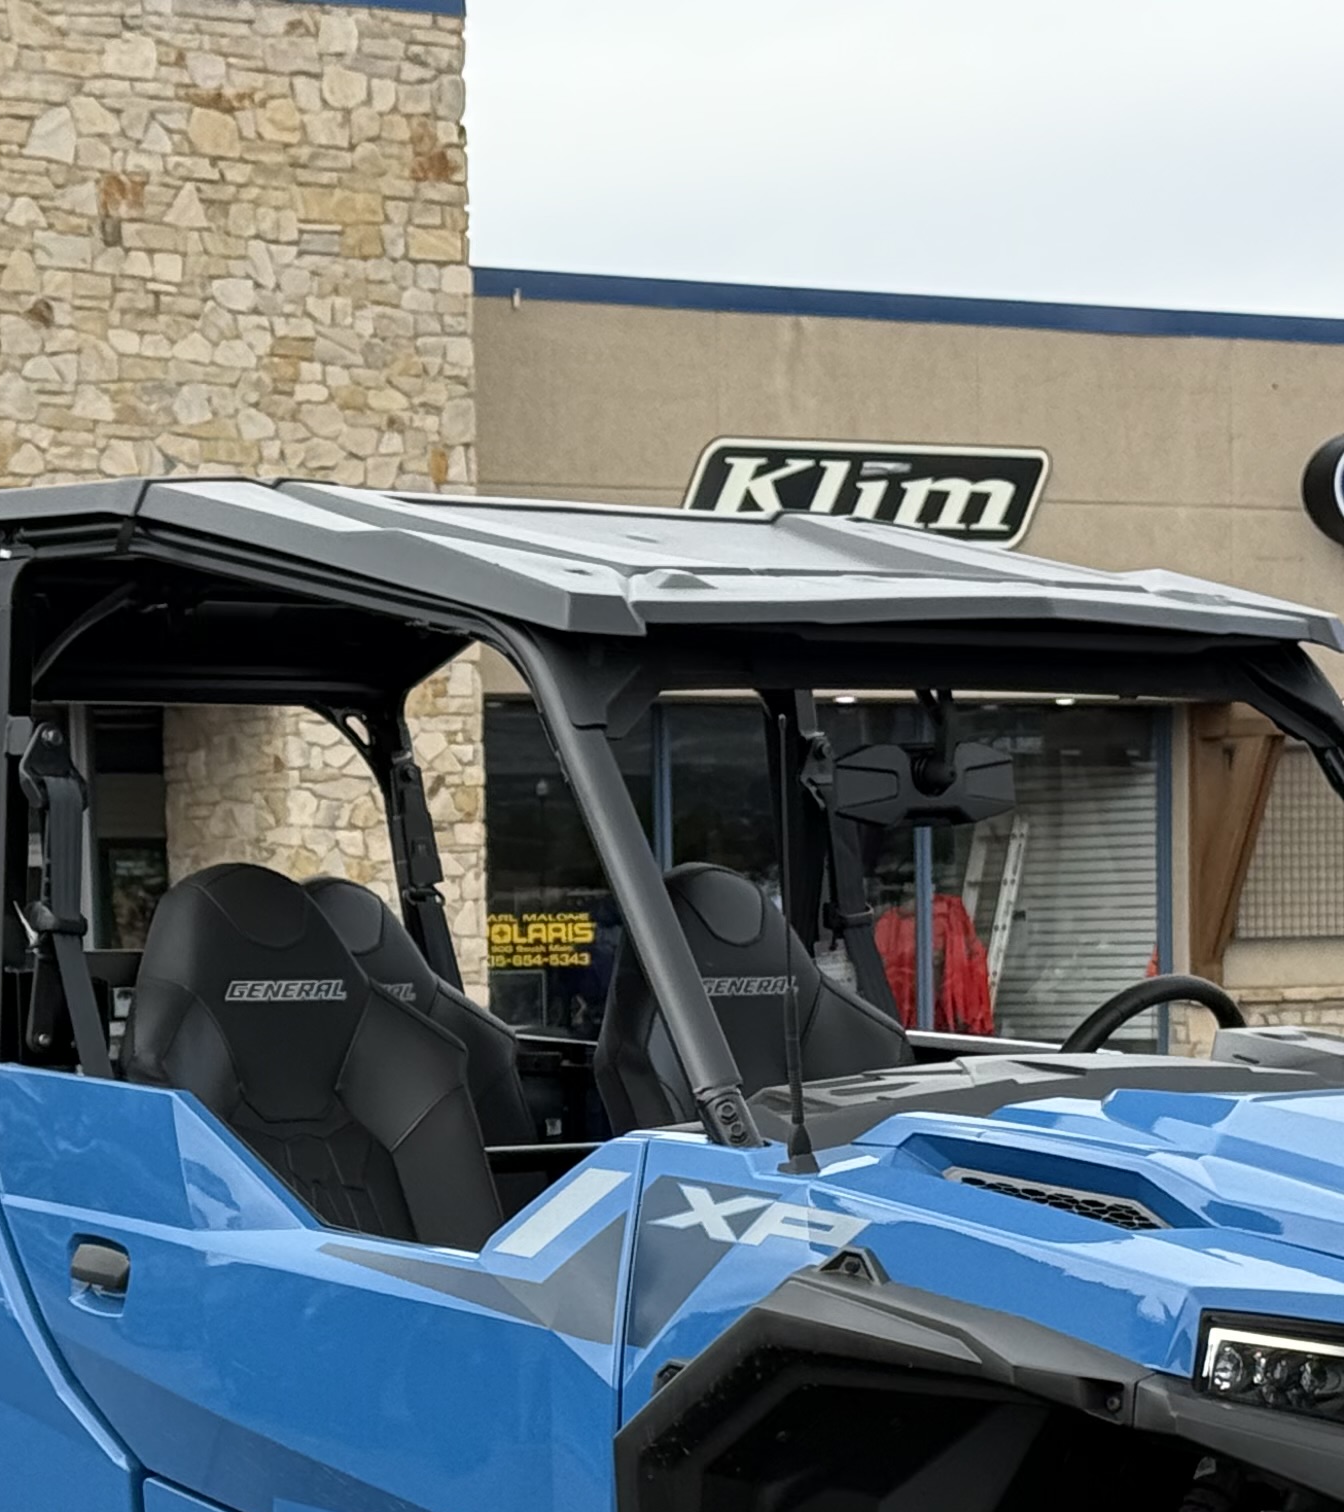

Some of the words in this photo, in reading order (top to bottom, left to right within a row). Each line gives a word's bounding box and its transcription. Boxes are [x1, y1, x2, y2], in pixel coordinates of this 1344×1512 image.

[713, 457, 1017, 532] Klim
[487, 913, 518, 922] ARL
[522, 912, 589, 922] MALONE
[487, 922, 595, 943] OLARIS
[224, 979, 347, 1001] GENERAL
[645, 1182, 873, 1247] XP
